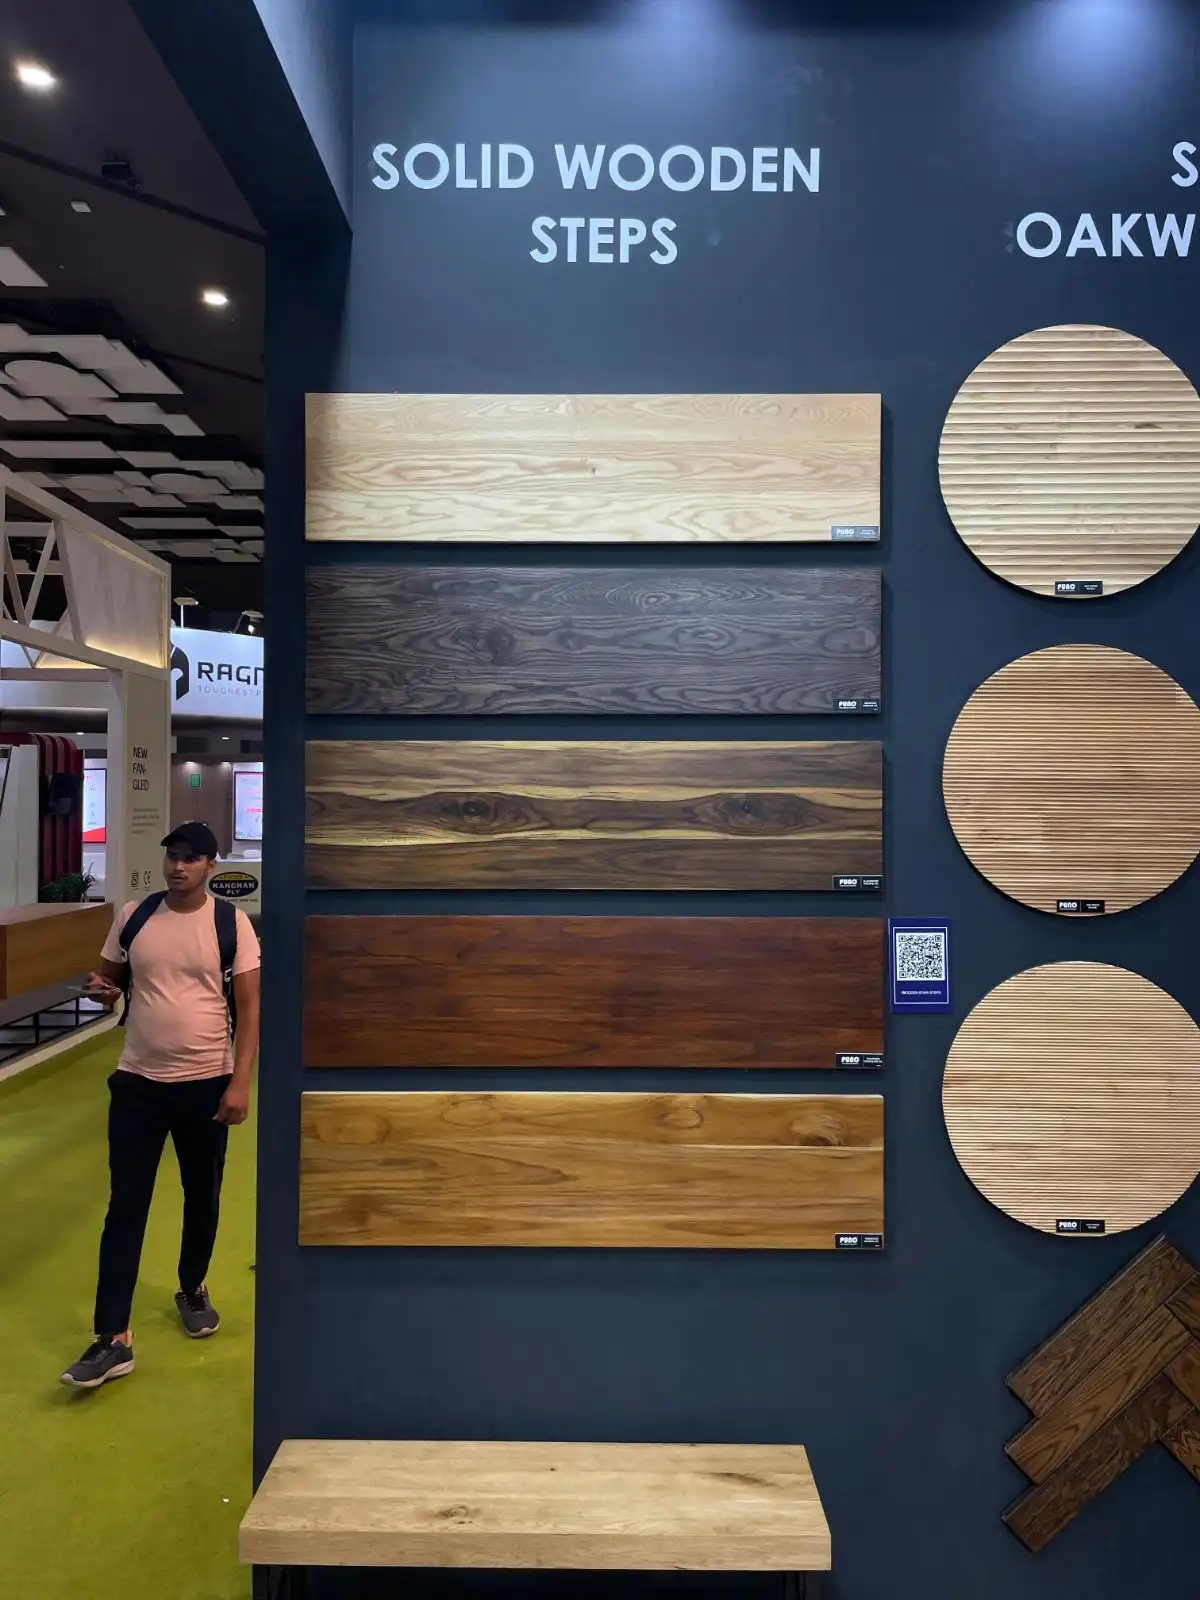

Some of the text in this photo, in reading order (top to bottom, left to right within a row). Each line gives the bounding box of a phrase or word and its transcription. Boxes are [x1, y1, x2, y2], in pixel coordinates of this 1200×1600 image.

[371, 142, 821, 193] SOLID WOODEN
[529, 215, 678, 265] STEPS
[1016, 212, 1196, 258] OAKW
[132, 745, 148, 759] NEW
[132, 762, 148, 775] FAN-
[132, 778, 150, 791] GLED
[212, 881, 255, 889] KANCHAN
